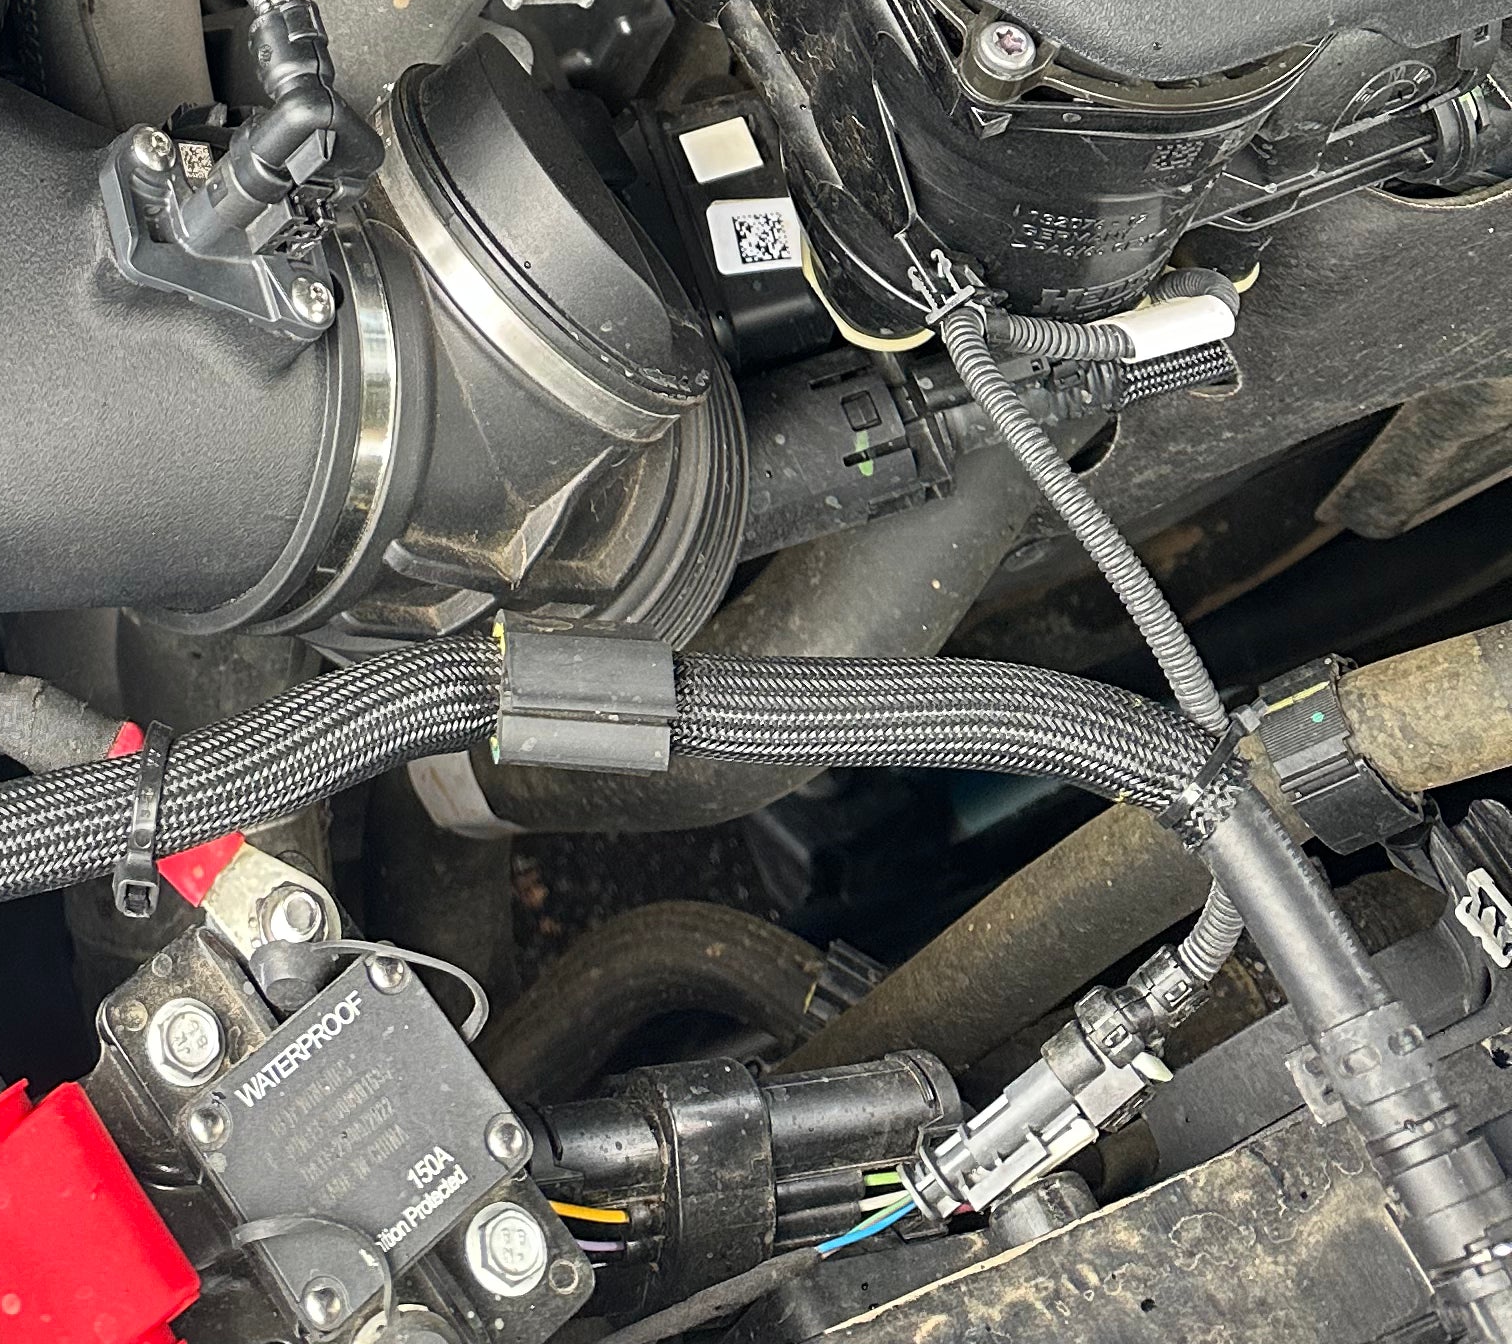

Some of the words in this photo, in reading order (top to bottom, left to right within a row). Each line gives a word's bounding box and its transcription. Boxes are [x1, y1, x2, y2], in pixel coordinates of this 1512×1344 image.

[233, 989, 364, 1109] WATERPROOF
[401, 1163, 469, 1229] Protected
[406, 1145, 456, 1190] 150A
